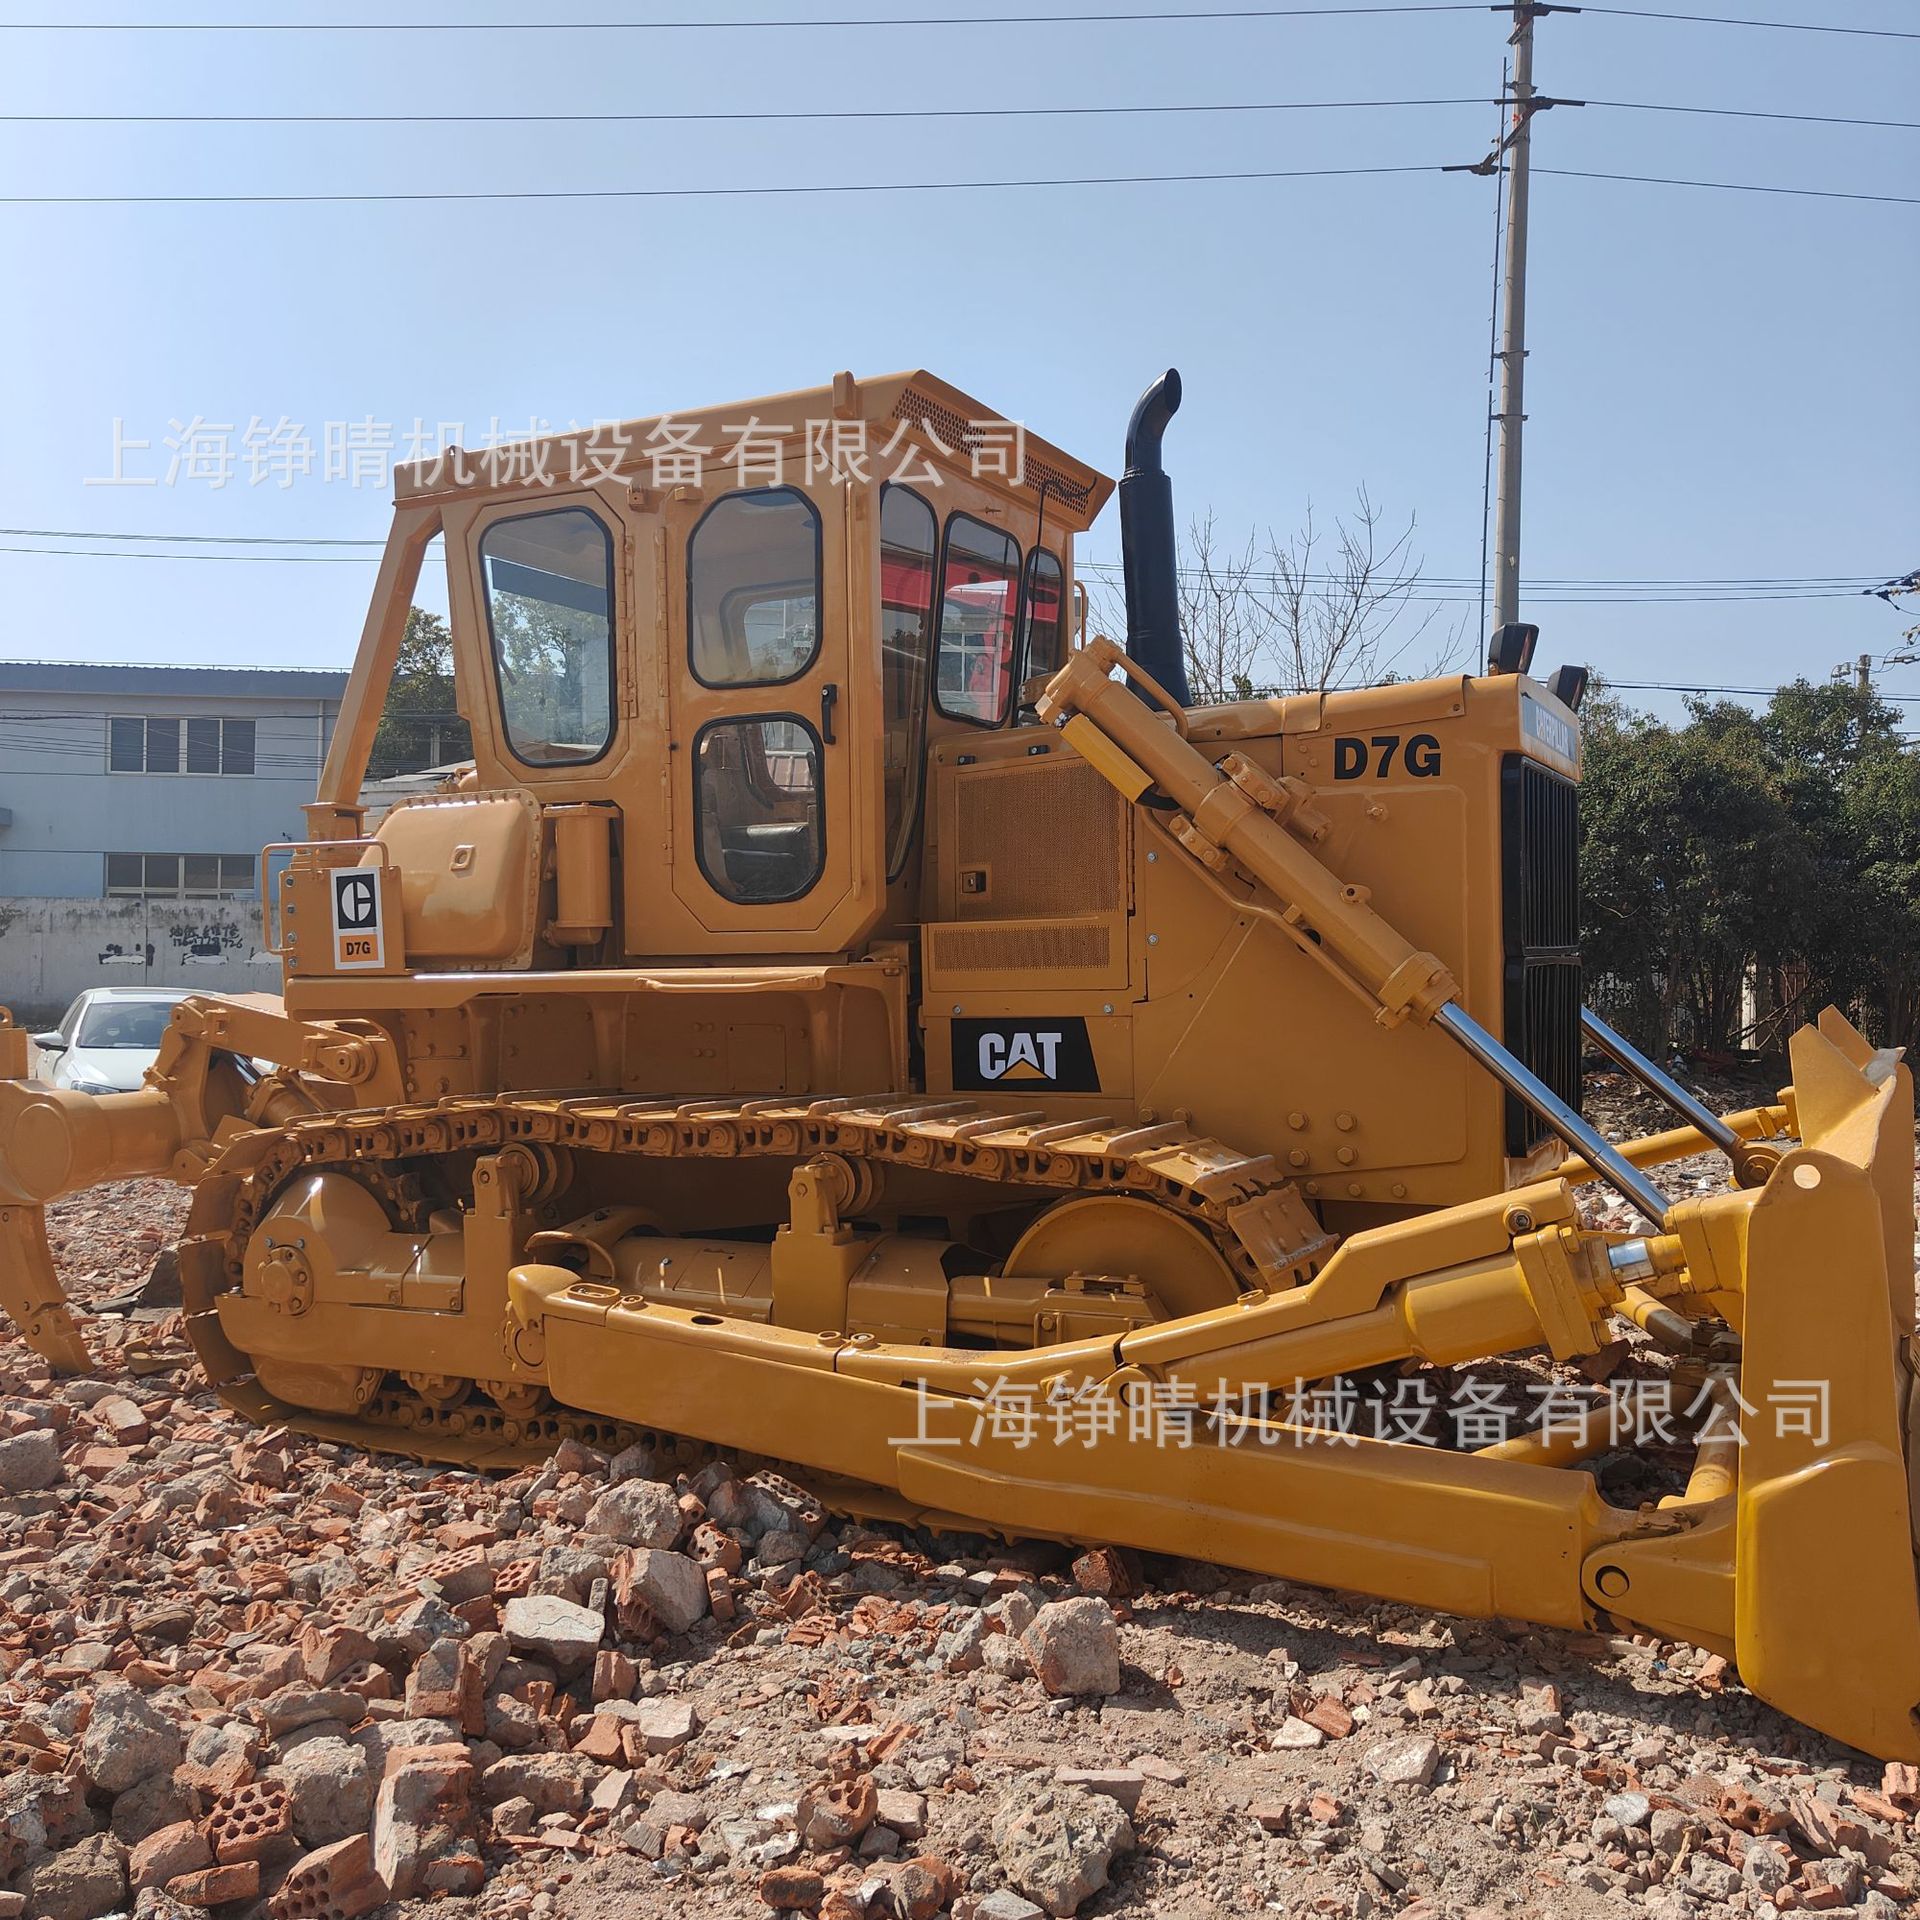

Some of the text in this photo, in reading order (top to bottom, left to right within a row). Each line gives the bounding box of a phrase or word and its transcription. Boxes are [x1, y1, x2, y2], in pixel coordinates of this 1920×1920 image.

[1334, 734, 1441, 780] D7G
[346, 941, 371, 956] D7G
[978, 1032, 1062, 1080] CAT
